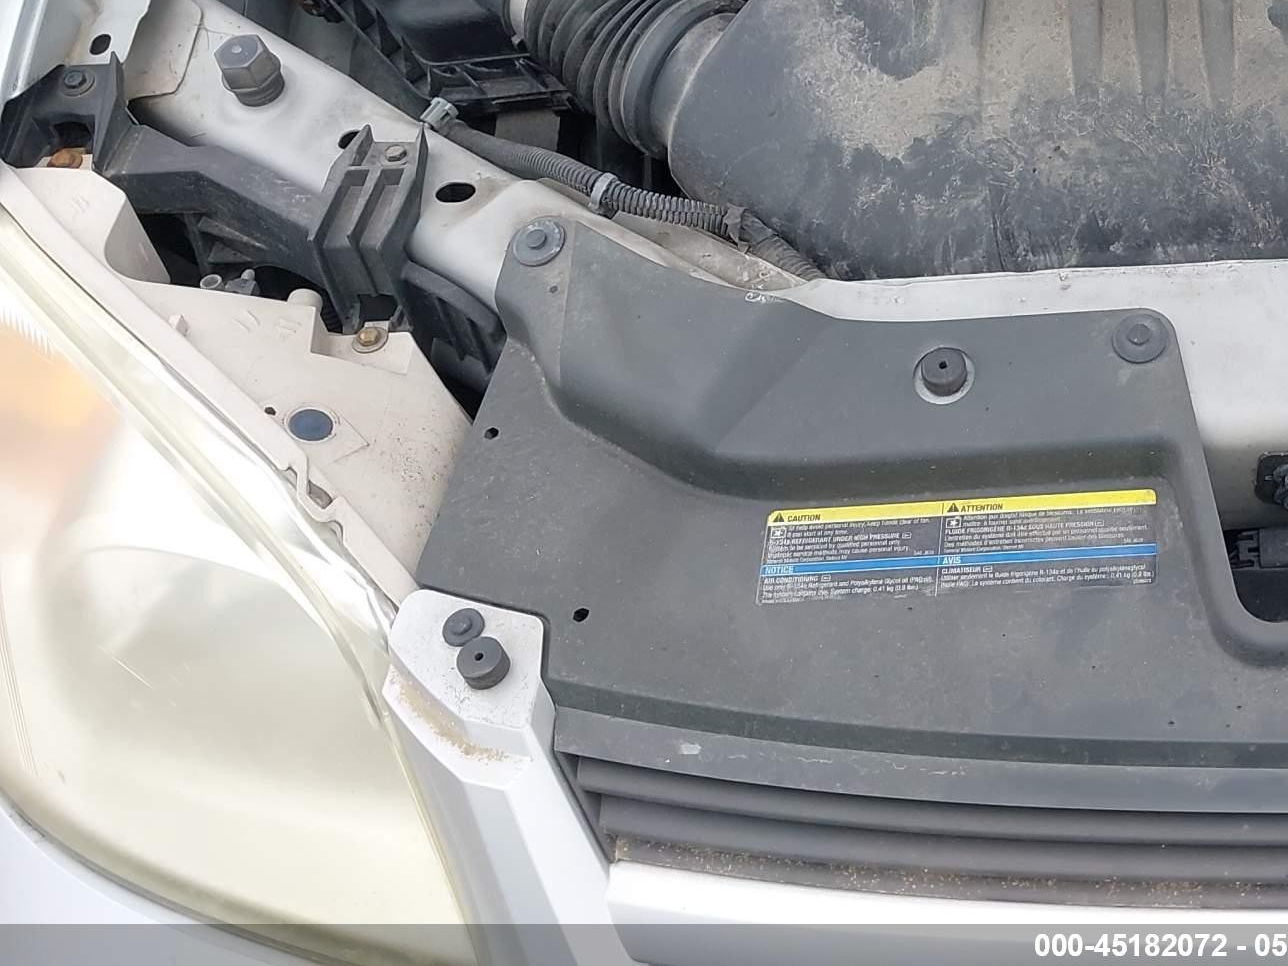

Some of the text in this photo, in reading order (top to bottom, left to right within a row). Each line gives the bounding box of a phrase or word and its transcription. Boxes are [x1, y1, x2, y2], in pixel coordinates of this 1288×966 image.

[960, 503, 1002, 512] ATTENTION
[787, 513, 820, 522] CAUTION
[942, 556, 960, 564] AVIS
[764, 565, 794, 574] NOTICE
[776, 575, 818, 583] CONDITIONING
